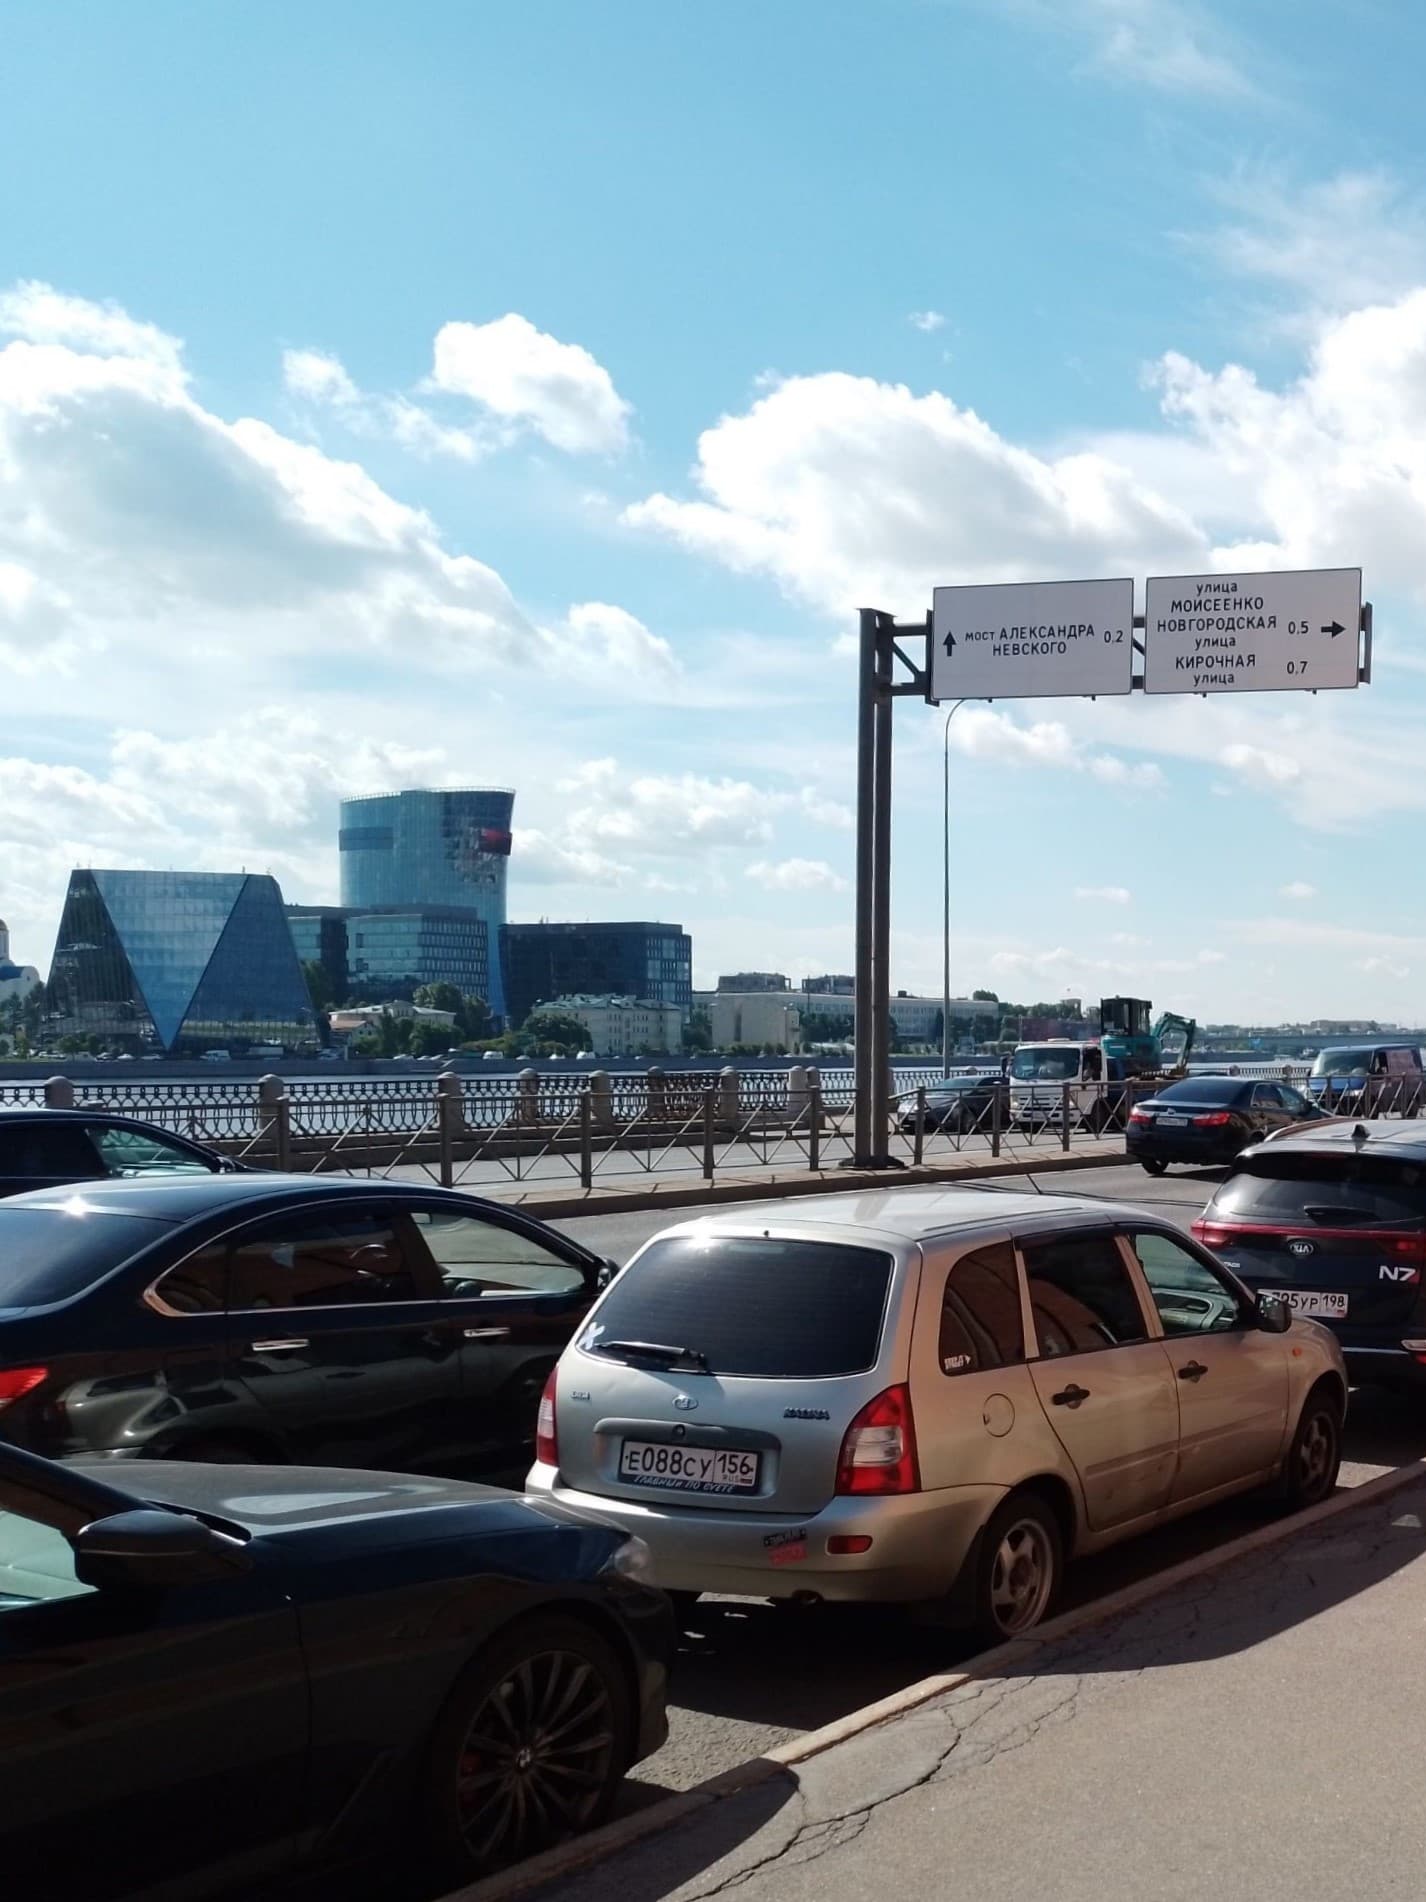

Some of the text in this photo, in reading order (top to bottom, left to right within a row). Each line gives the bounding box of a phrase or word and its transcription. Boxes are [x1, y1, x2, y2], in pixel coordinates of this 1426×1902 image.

[1196, 582, 1238, 596] улица
[1170, 596, 1264, 613] МОИСЕЕНКО
[1157, 615, 1277, 633] НОВГОРОДСКАЯ
[964, 623, 1095, 642] мост АЛЕКСАНДРА
[992, 641, 1067, 657] НЕВСКОГО
[1194, 636, 1237, 651] улица
[1175, 653, 1256, 670] КИРОЧНАЯ
[1193, 672, 1235, 687] улица
[1293, 1244, 1311, 1254] KIA
[1378, 1265, 1417, 1283] N7
[1322, 1294, 1345, 1308] 198
[628, 1446, 750, 1479] Е088СУ 156
[684, 1481, 701, 1490] ПО
